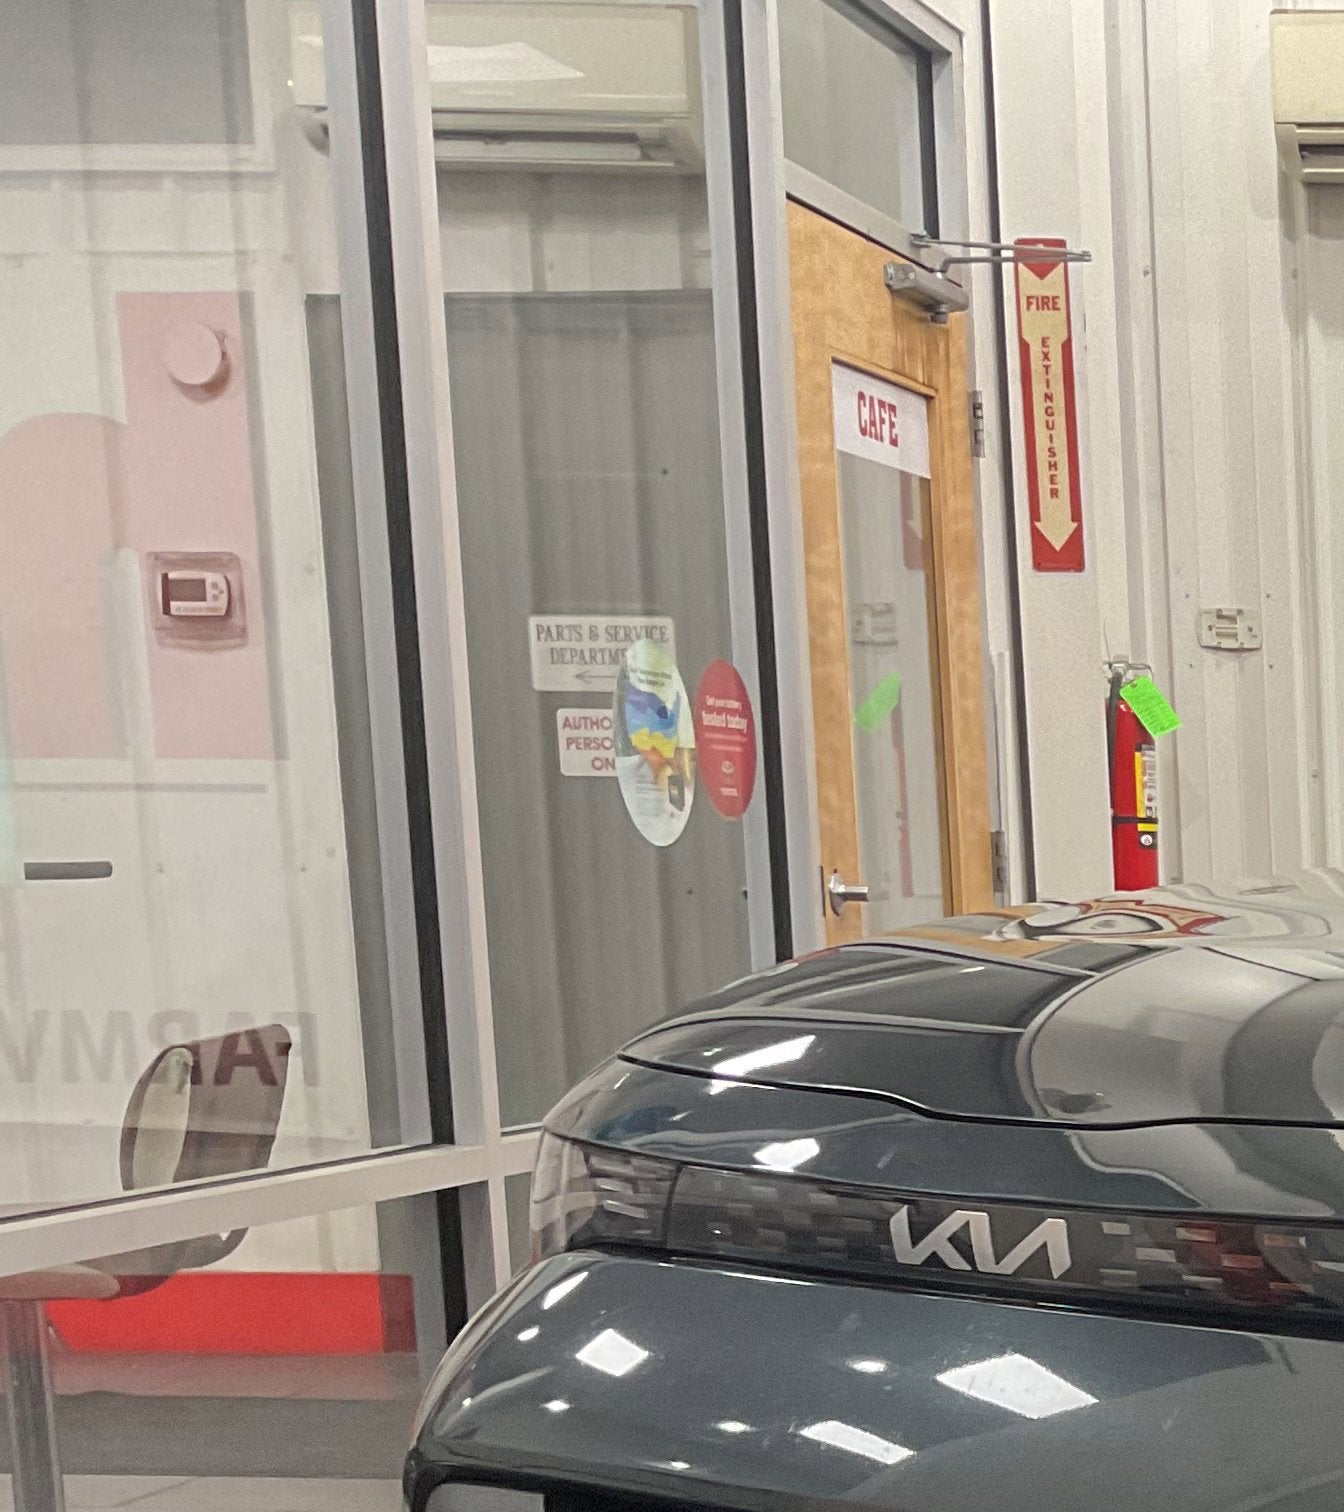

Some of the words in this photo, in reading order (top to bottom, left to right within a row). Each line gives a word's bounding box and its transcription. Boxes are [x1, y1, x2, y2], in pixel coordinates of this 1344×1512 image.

[1026, 295, 1061, 312] FIRE
[857, 390, 899, 448] CAFE
[1041, 336, 1060, 499] EXTINGUISHER
[535, 624, 583, 642] PARTS
[588, 625, 599, 641] &
[604, 624, 669, 643] SERVICE
[550, 647, 627, 666] DEPARTM
[562, 716, 612, 730] AUTHO
[566, 737, 614, 750] PERSO
[591, 757, 616, 771] ON
[889, 1204, 1072, 1280] KIA
